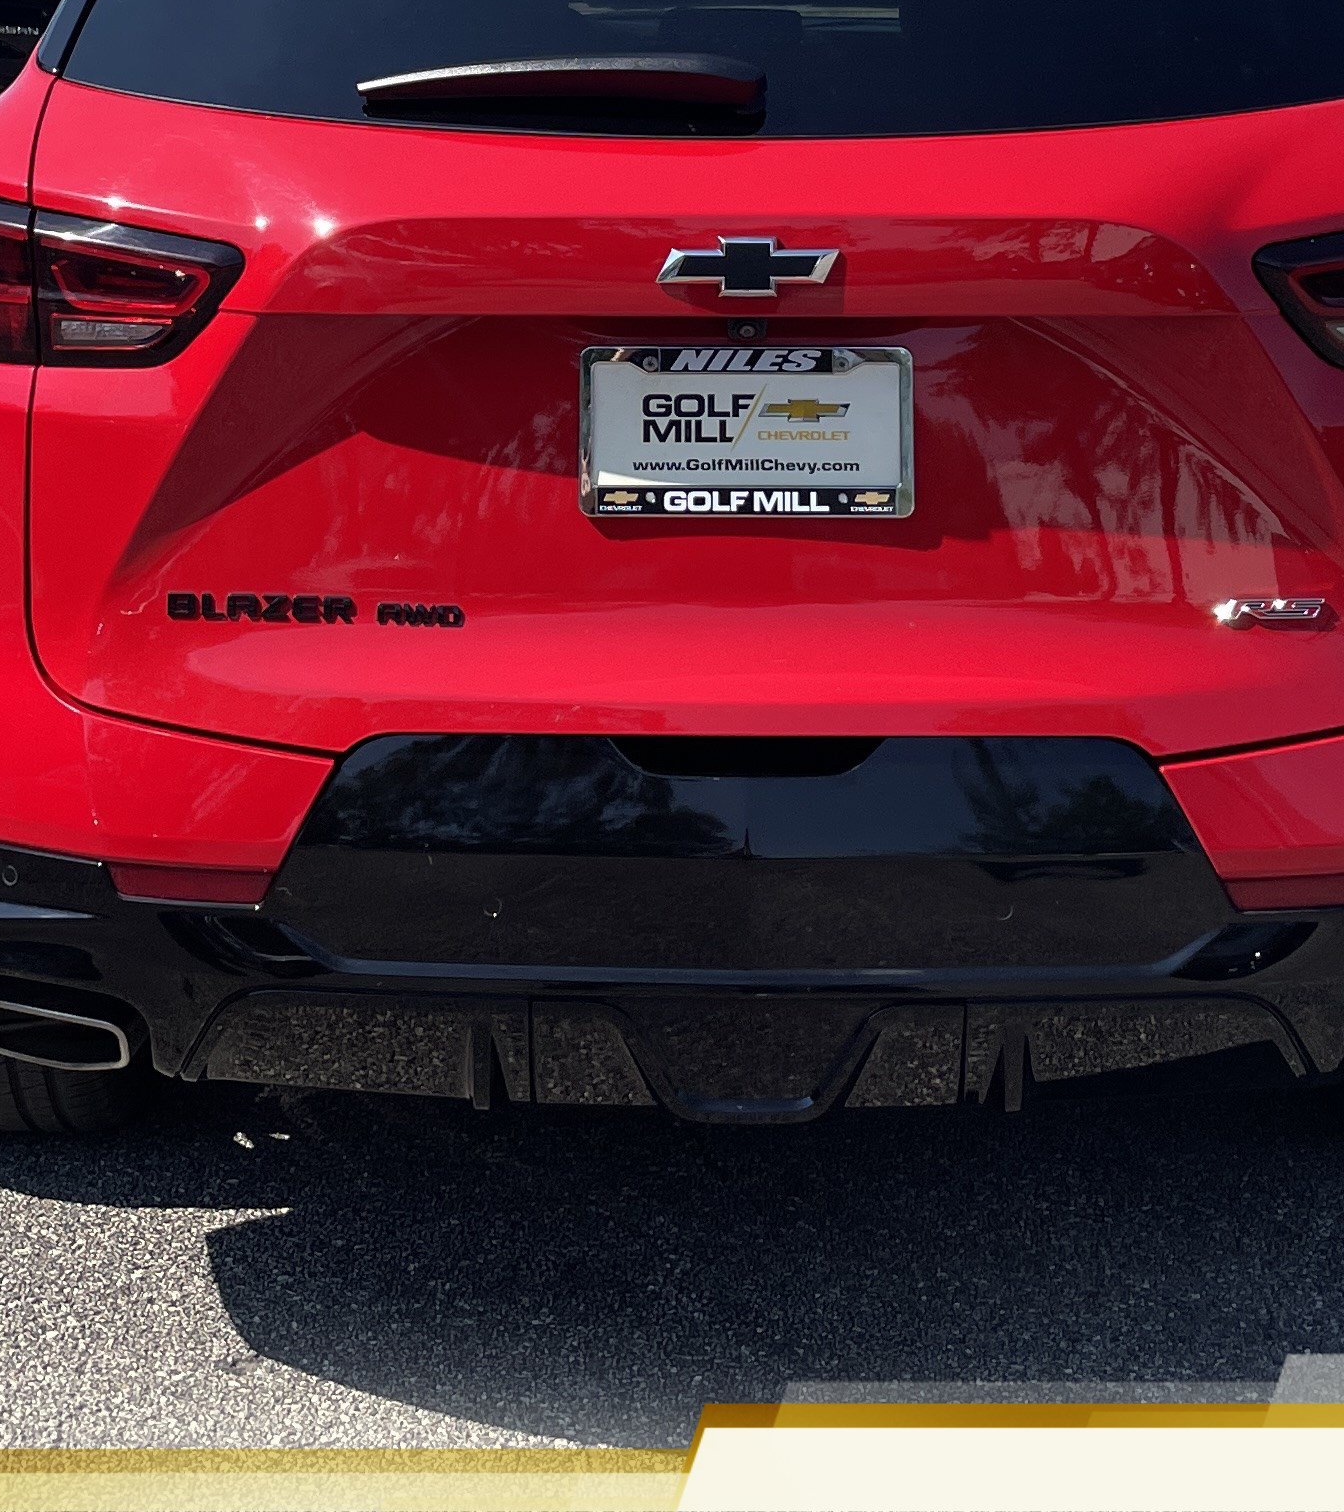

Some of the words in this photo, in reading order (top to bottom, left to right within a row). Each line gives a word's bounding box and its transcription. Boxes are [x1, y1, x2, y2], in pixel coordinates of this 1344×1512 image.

[670, 348, 822, 372] NILES
[642, 393, 756, 418] GOLF
[642, 419, 735, 443] MILL
[758, 430, 850, 441] CHEVROLET
[632, 458, 860, 474] www.GolfMillChevy.com
[663, 490, 748, 512] GOLF
[753, 491, 829, 512] MILL
[167, 592, 358, 624] BLAZER
[376, 602, 466, 628] AWD
[1213, 598, 1325, 623] RS
